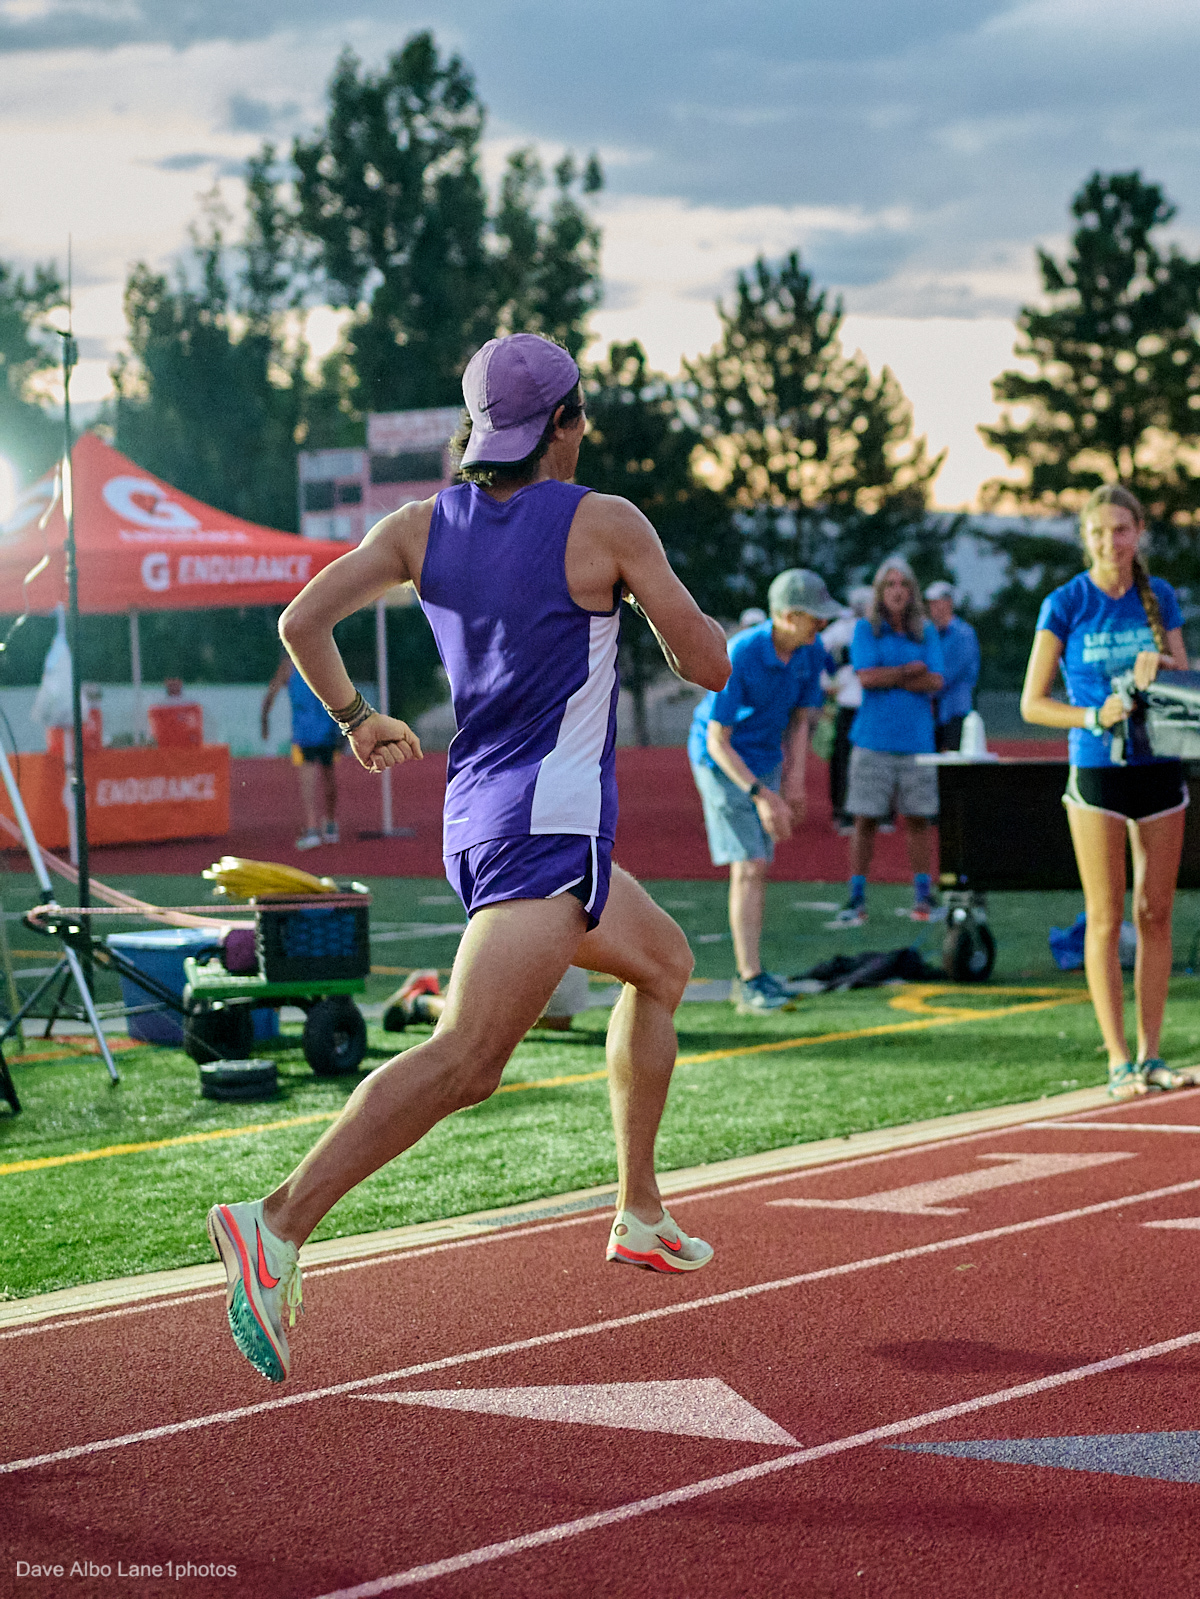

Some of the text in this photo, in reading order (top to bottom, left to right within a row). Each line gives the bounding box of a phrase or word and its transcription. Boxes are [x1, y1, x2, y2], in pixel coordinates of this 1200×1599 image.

[102, 475, 203, 528] G
[141, 552, 313, 592] G ENDURANCE
[96, 773, 216, 806] ENDURANCE
[765, 1152, 1138, 1216] 1
